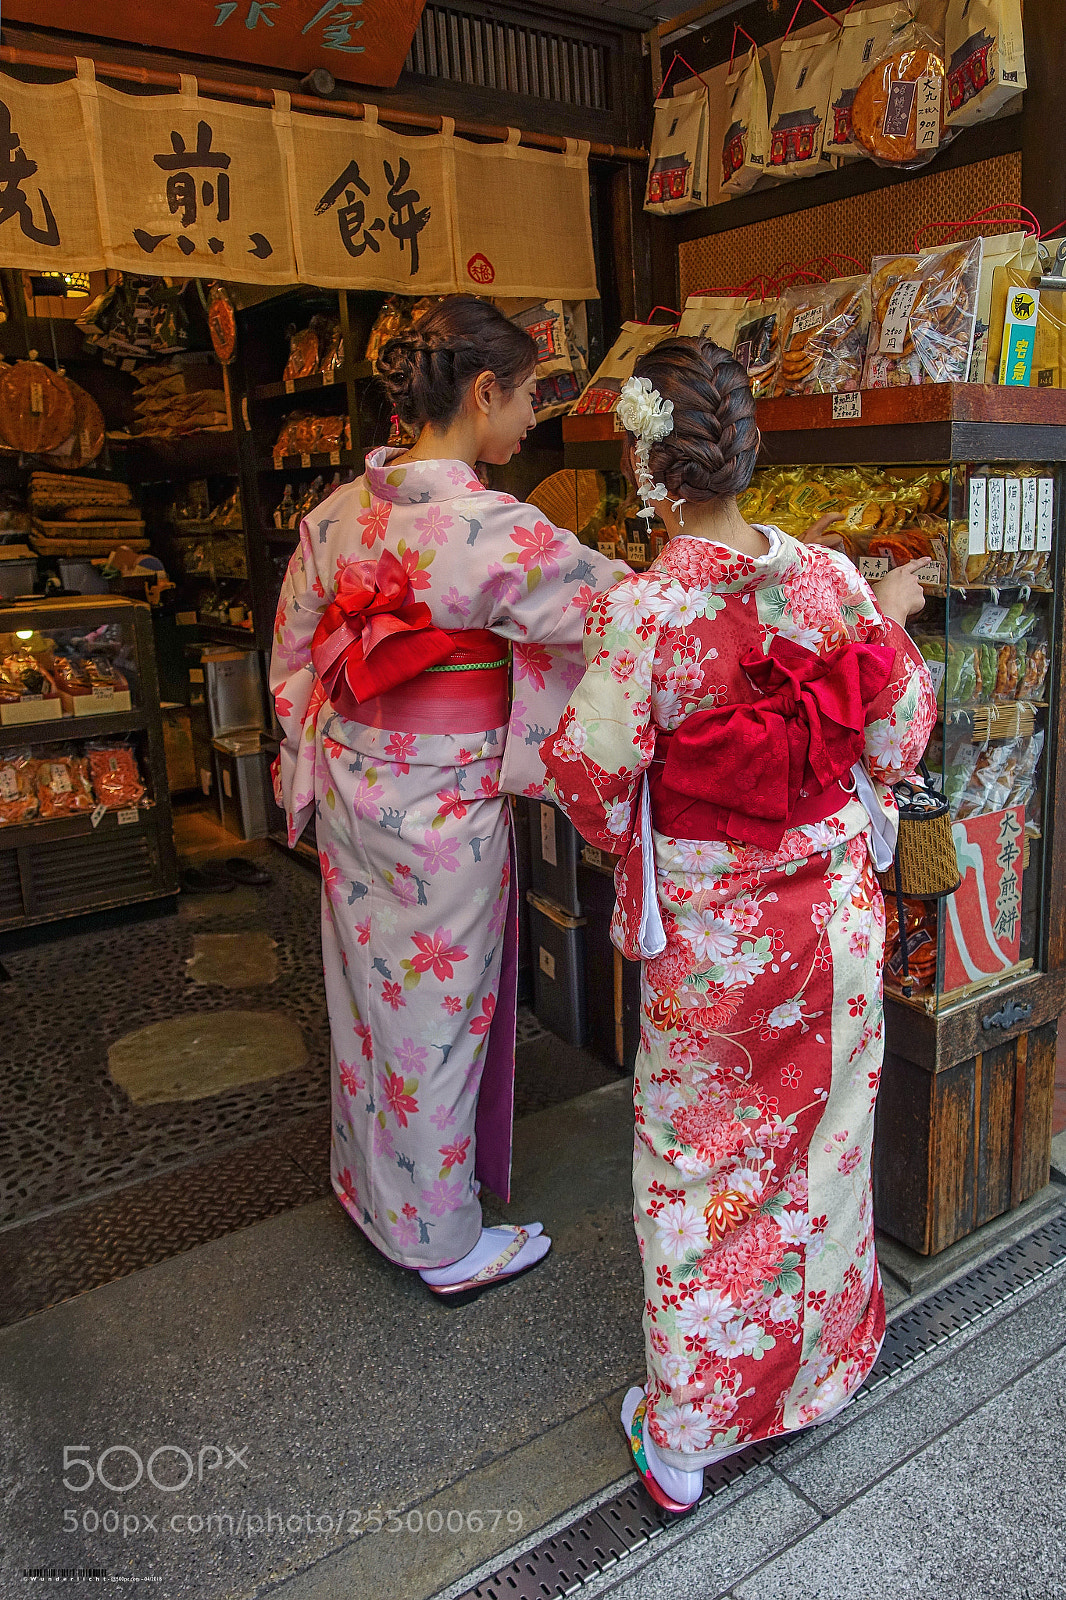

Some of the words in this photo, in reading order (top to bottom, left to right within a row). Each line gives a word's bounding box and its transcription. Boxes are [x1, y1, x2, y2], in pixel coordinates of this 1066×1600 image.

[1012, 339, 1028, 386] 宅急
[994, 812, 1020, 942] 大辛煎餅
